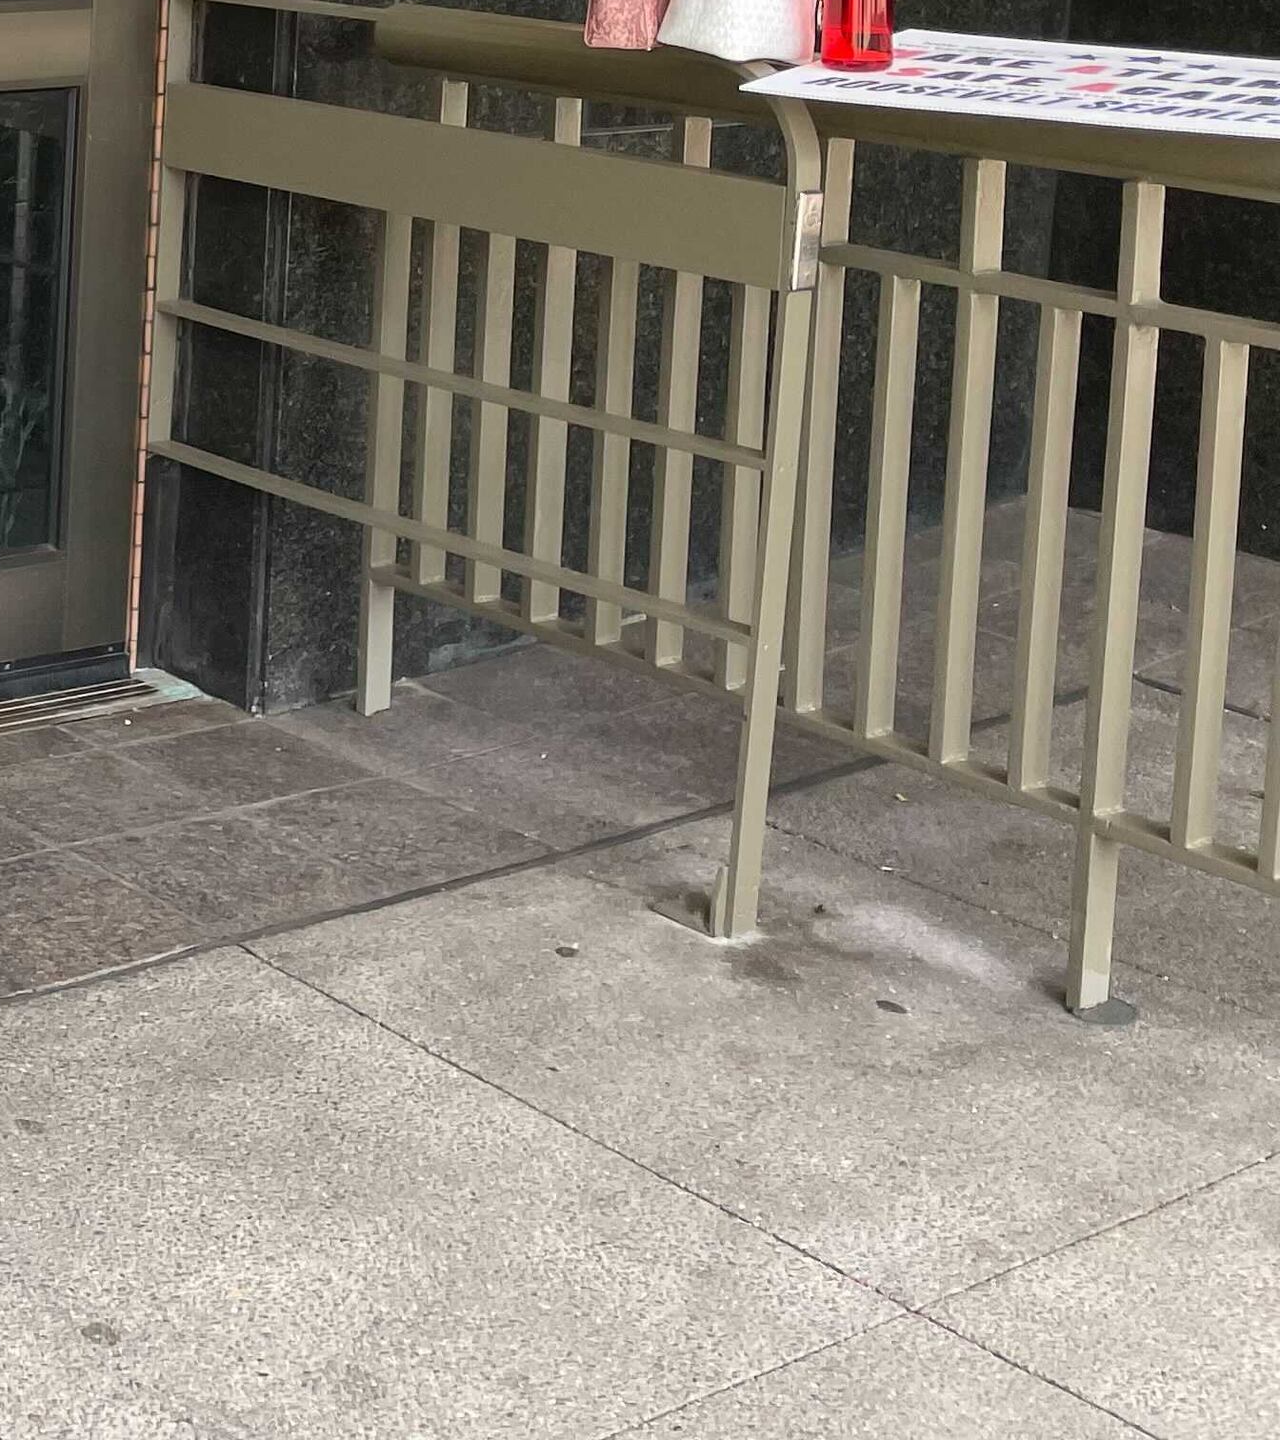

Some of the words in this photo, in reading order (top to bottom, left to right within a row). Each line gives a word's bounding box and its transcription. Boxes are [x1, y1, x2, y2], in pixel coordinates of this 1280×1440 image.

[886, 67, 1064, 87] SAFE
[1056, 66, 1280, 89] ATLAN
[803, 76, 1083, 106] ROOSEVELT
[1079, 100, 1280, 125] SEARLE
